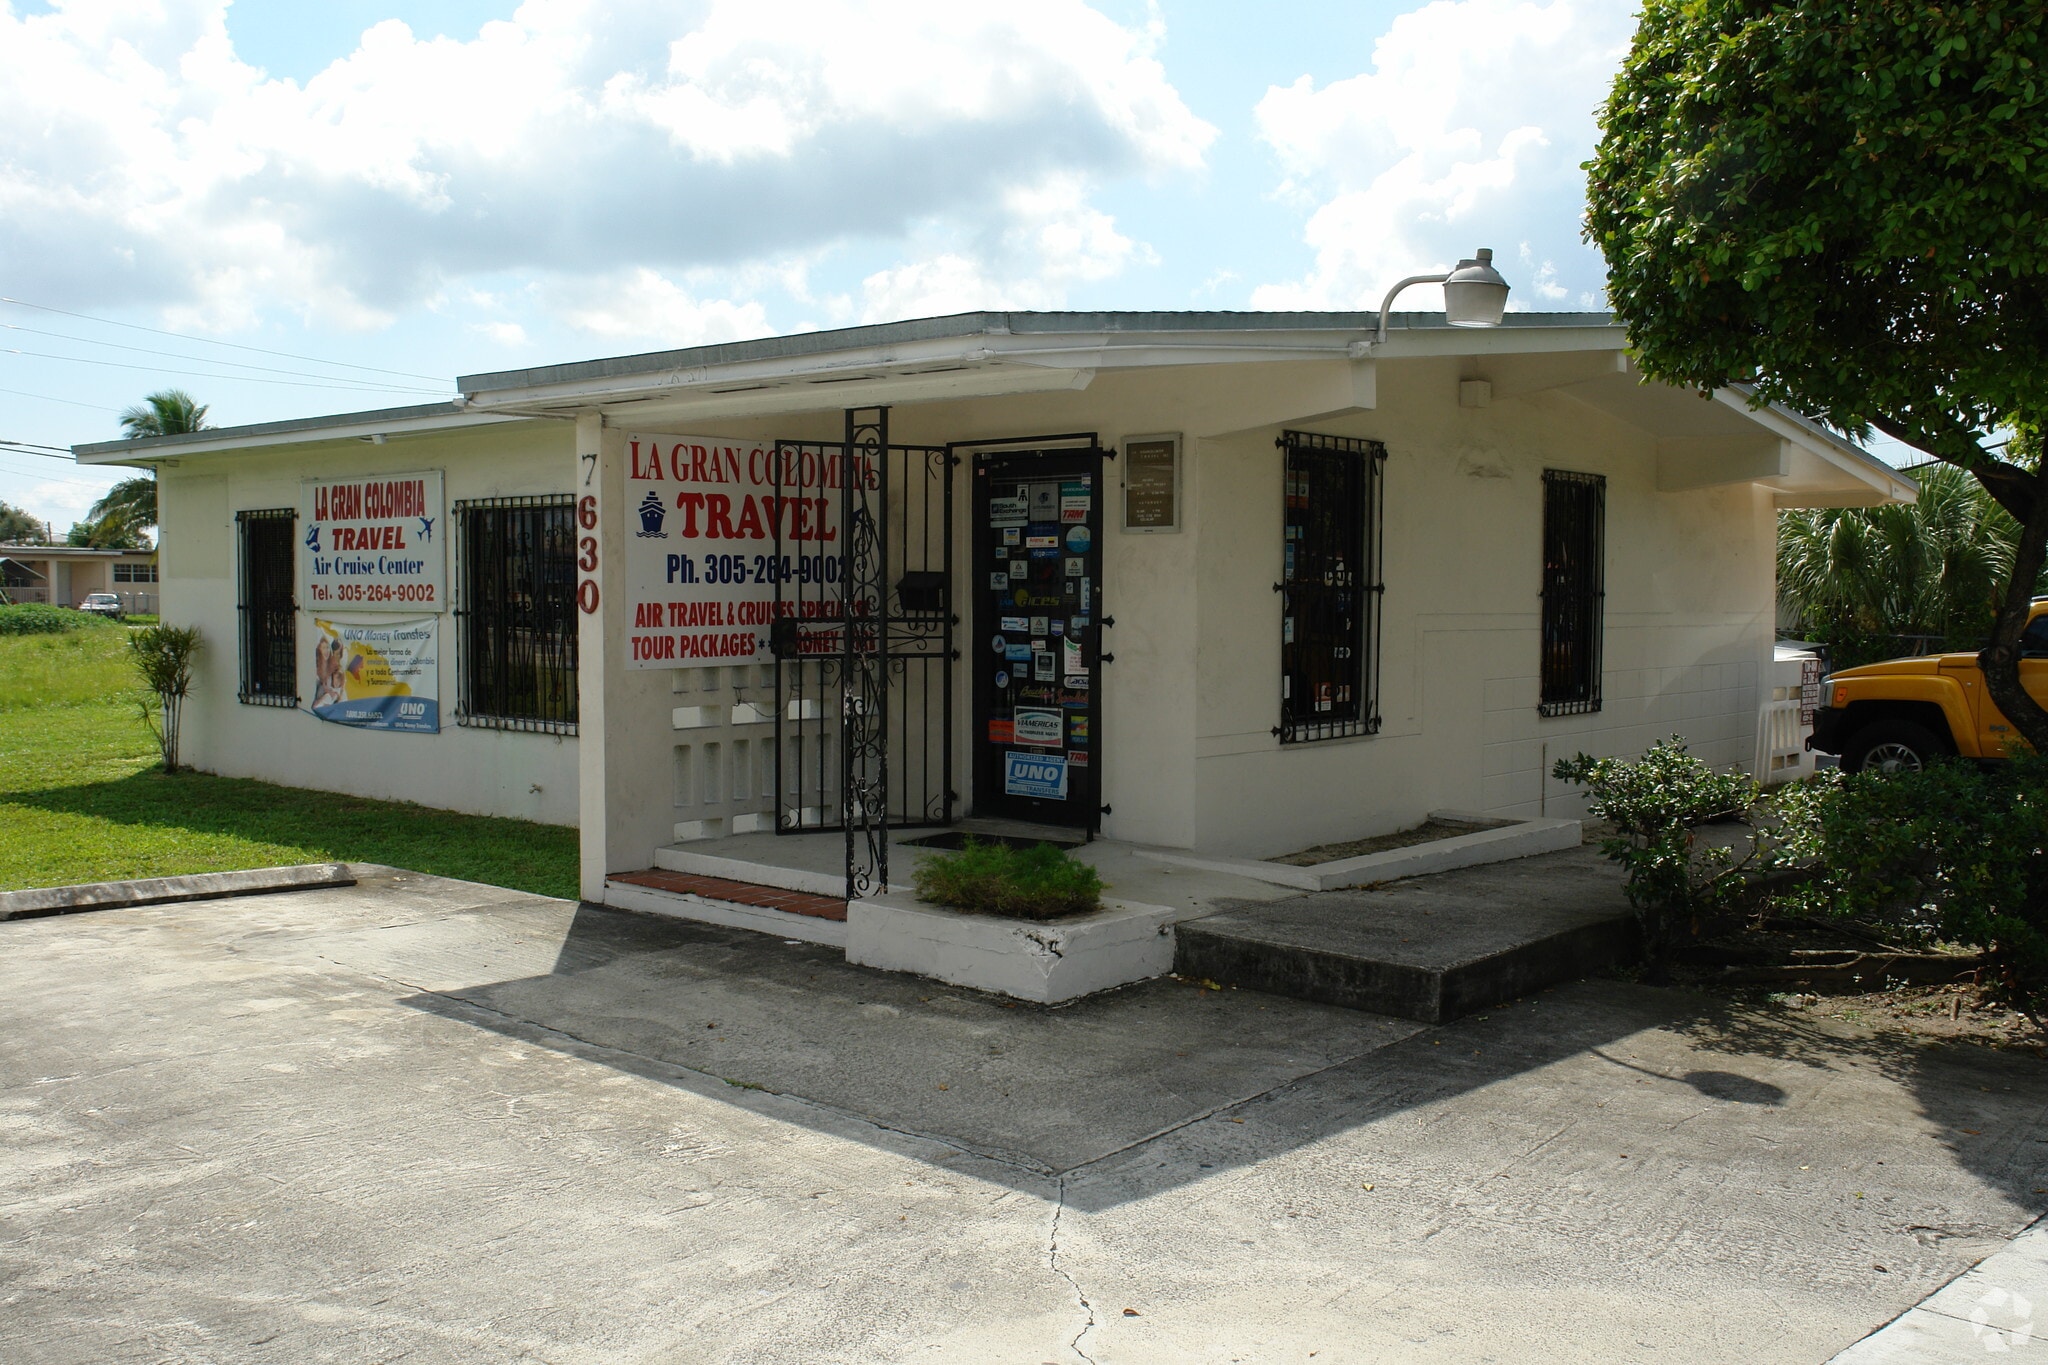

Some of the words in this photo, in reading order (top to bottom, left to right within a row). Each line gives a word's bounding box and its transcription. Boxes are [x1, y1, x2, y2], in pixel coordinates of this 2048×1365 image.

[629, 441, 664, 480] LA
[671, 443, 742, 484] GRAN
[315, 486, 328, 521] LA
[331, 484, 361, 521] GRAN
[365, 480, 425, 519] COLOMBIA
[677, 491, 837, 542] TRAVEL
[1063, 510, 1085, 519] TAM
[332, 526, 406, 551] TRAVEL
[312, 557, 331, 575] Air
[334, 556, 375, 575] Cruise
[378, 555, 423, 575] Center
[667, 554, 700, 584] Ph.
[704, 554, 847, 584] 305-264-9002
[311, 584, 332, 600] Tel.
[338, 583, 434, 601] 305-264-9002
[635, 602, 663, 628] AIR
[668, 602, 723, 627] TRAVEL
[727, 602, 735, 625] &
[737, 601, 795, 625] CRUISES
[344, 629, 363, 641] UNO
[364, 630, 392, 644] Money
[374, 649, 388, 658] mejor
[405, 648, 412, 656] de
[632, 636, 675, 661] TOUR
[680, 633, 756, 658] PACKAGES
[400, 702, 425, 715] UNO
[1017, 719, 1058, 729] VIAMERICAS
[1046, 756, 1065, 764] AGENT
[1070, 752, 1089, 762] TAM
[1014, 763, 1058, 781] UNO
[1026, 786, 1060, 795] TRANSFERS
